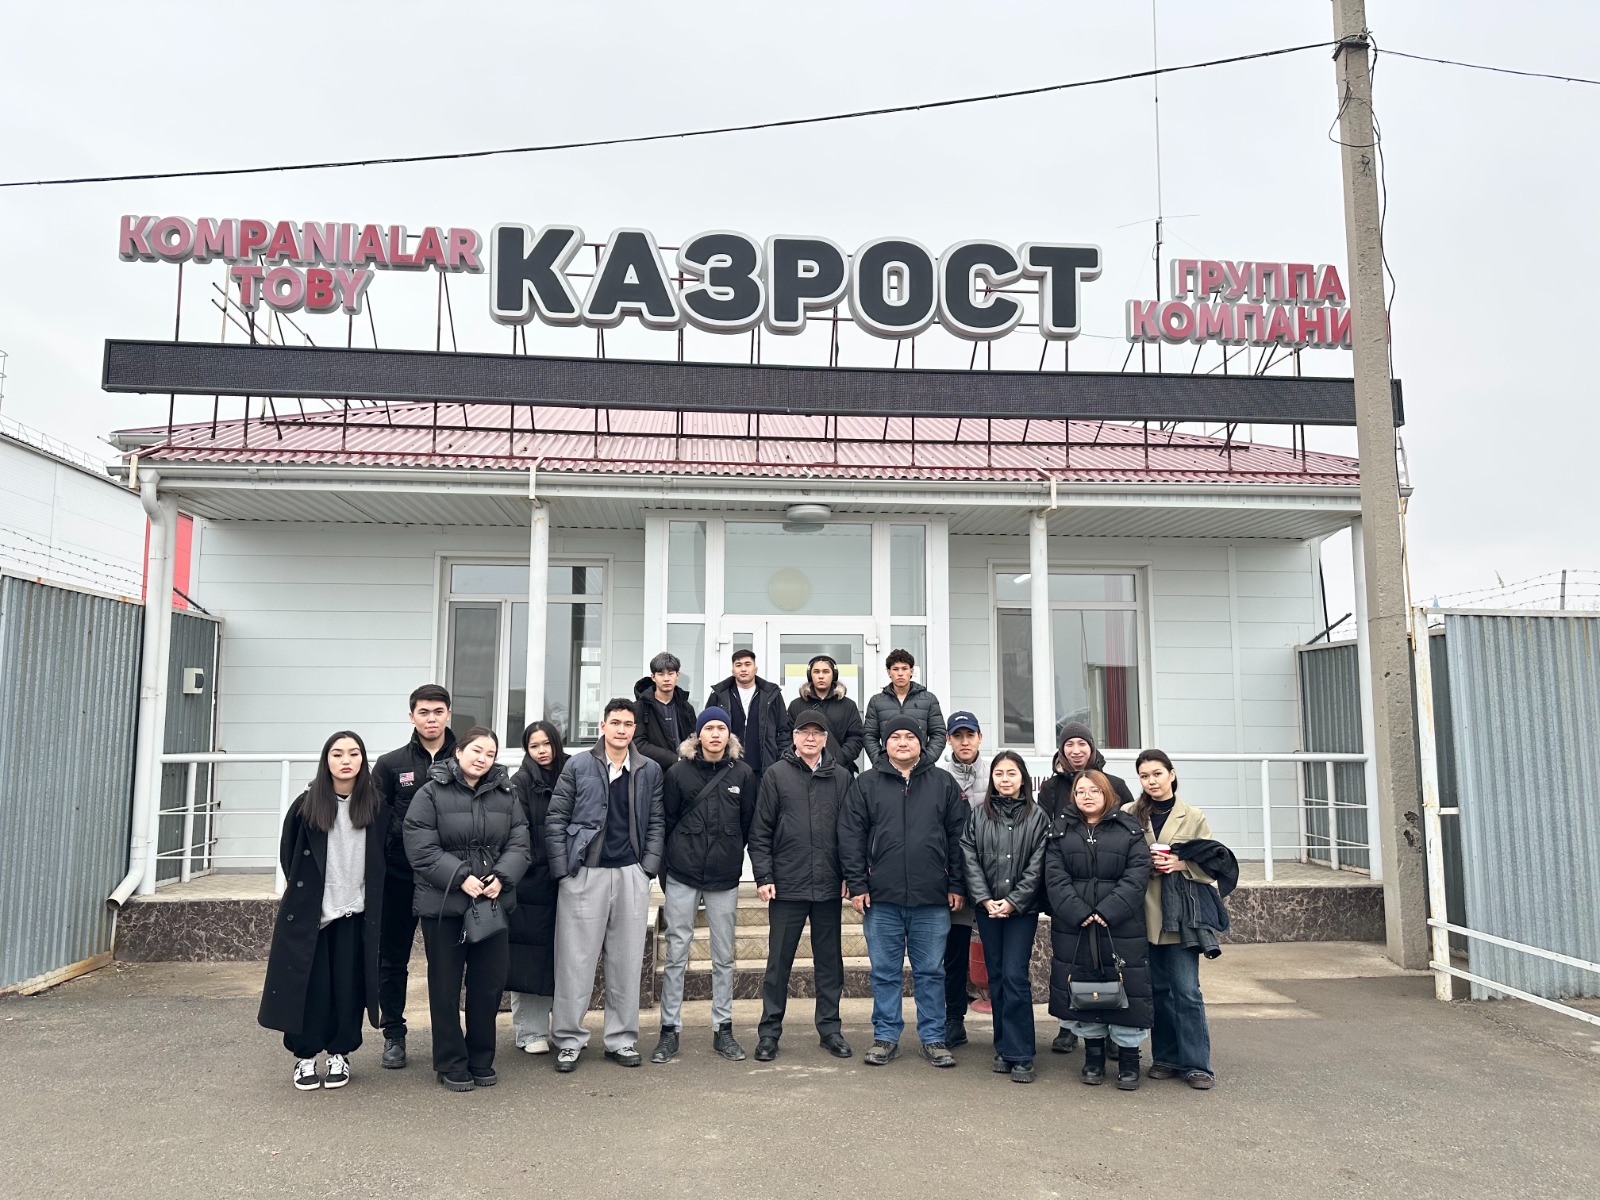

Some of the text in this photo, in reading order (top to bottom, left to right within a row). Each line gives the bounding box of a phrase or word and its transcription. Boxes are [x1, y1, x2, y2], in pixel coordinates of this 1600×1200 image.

[119, 215, 484, 273] KOMPANIALAR
[231, 266, 374, 314] TOBY
[491, 222, 1102, 340] КАЗРОСТ
[1171, 259, 1346, 306] ГРУППА
[1126, 299, 1389, 349] КОМПАНИ
